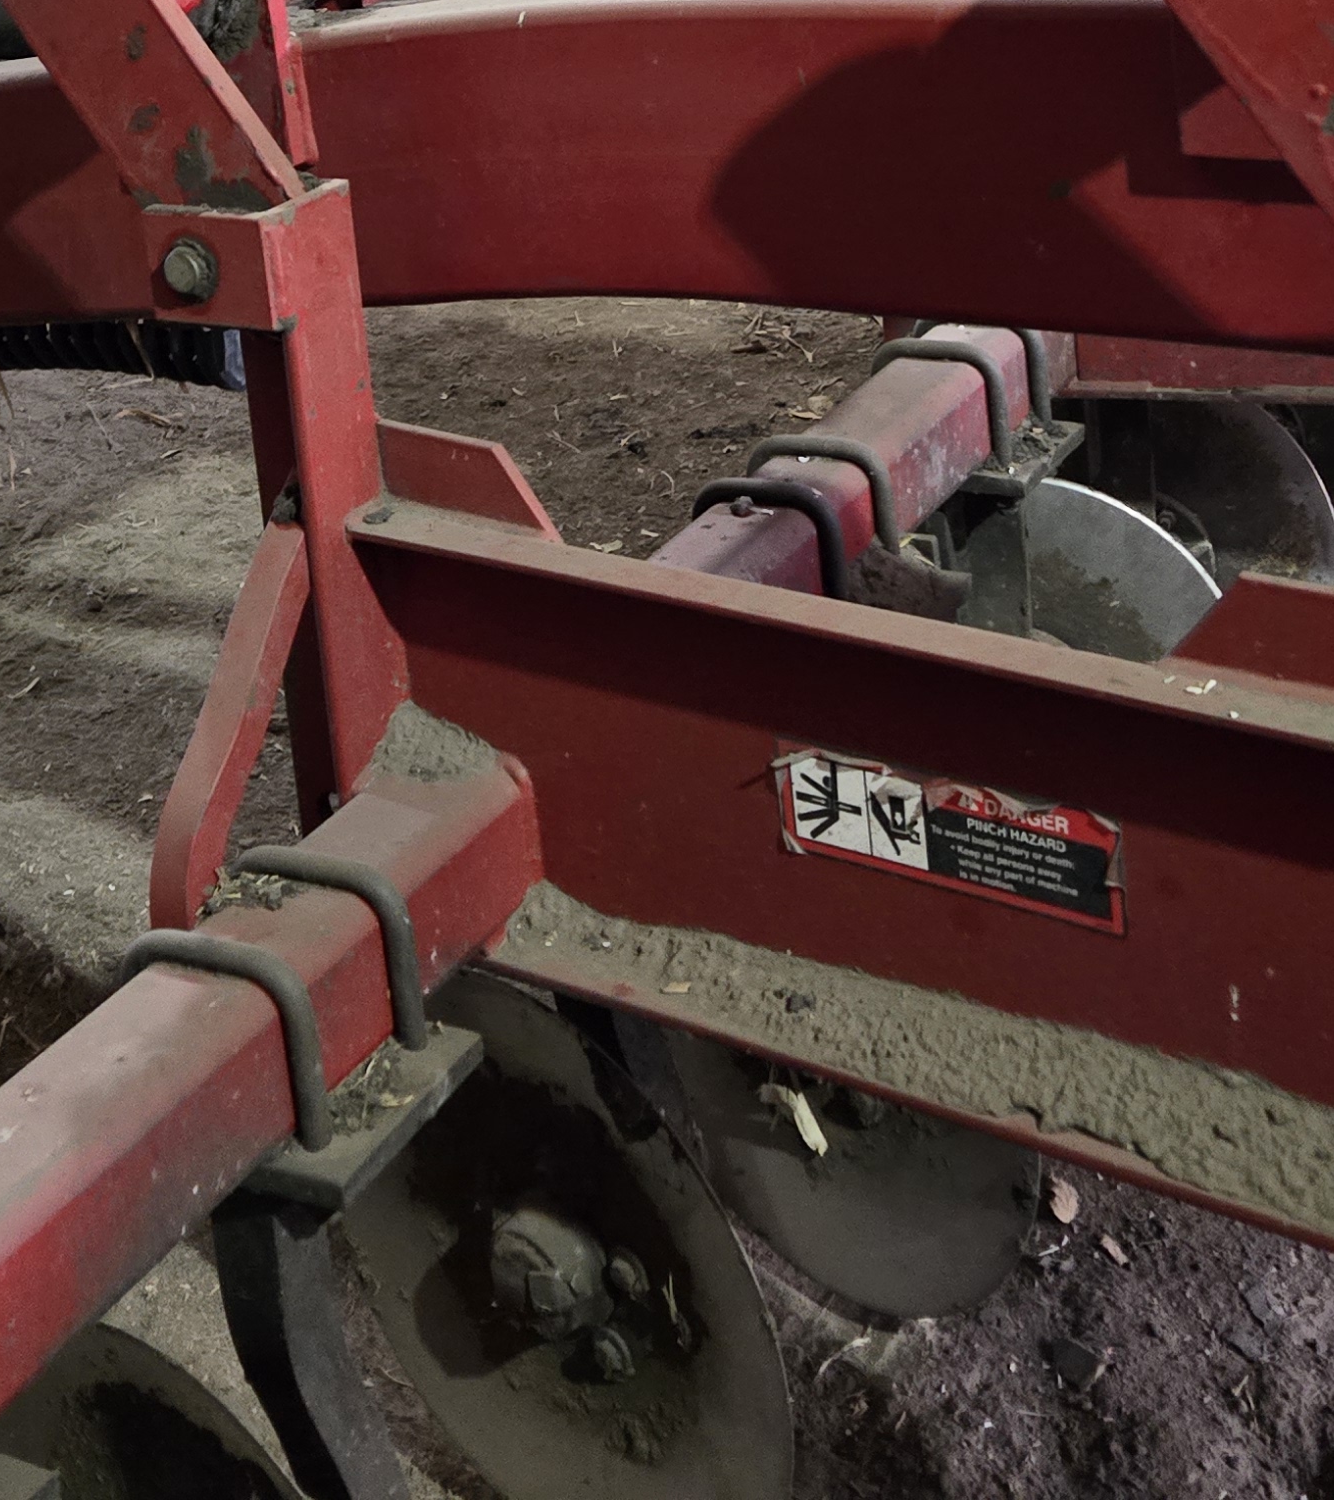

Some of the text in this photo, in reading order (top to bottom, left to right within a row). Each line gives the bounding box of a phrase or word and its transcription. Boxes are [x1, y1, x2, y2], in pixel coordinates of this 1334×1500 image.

[930, 823, 943, 835] To
[944, 829, 970, 842] avoid
[971, 835, 1000, 852] bodily
[1003, 844, 1029, 860] injury
[1032, 851, 1043, 861] or
[966, 817, 1067, 853] PINCH HAZARD
[958, 858, 1079, 897] while any part of machine
[959, 869, 968, 879] is
[970, 873, 980, 882] in
[983, 851, 995, 862] all
[996, 855, 1035, 873] persons
[1037, 867, 1062, 882] away
